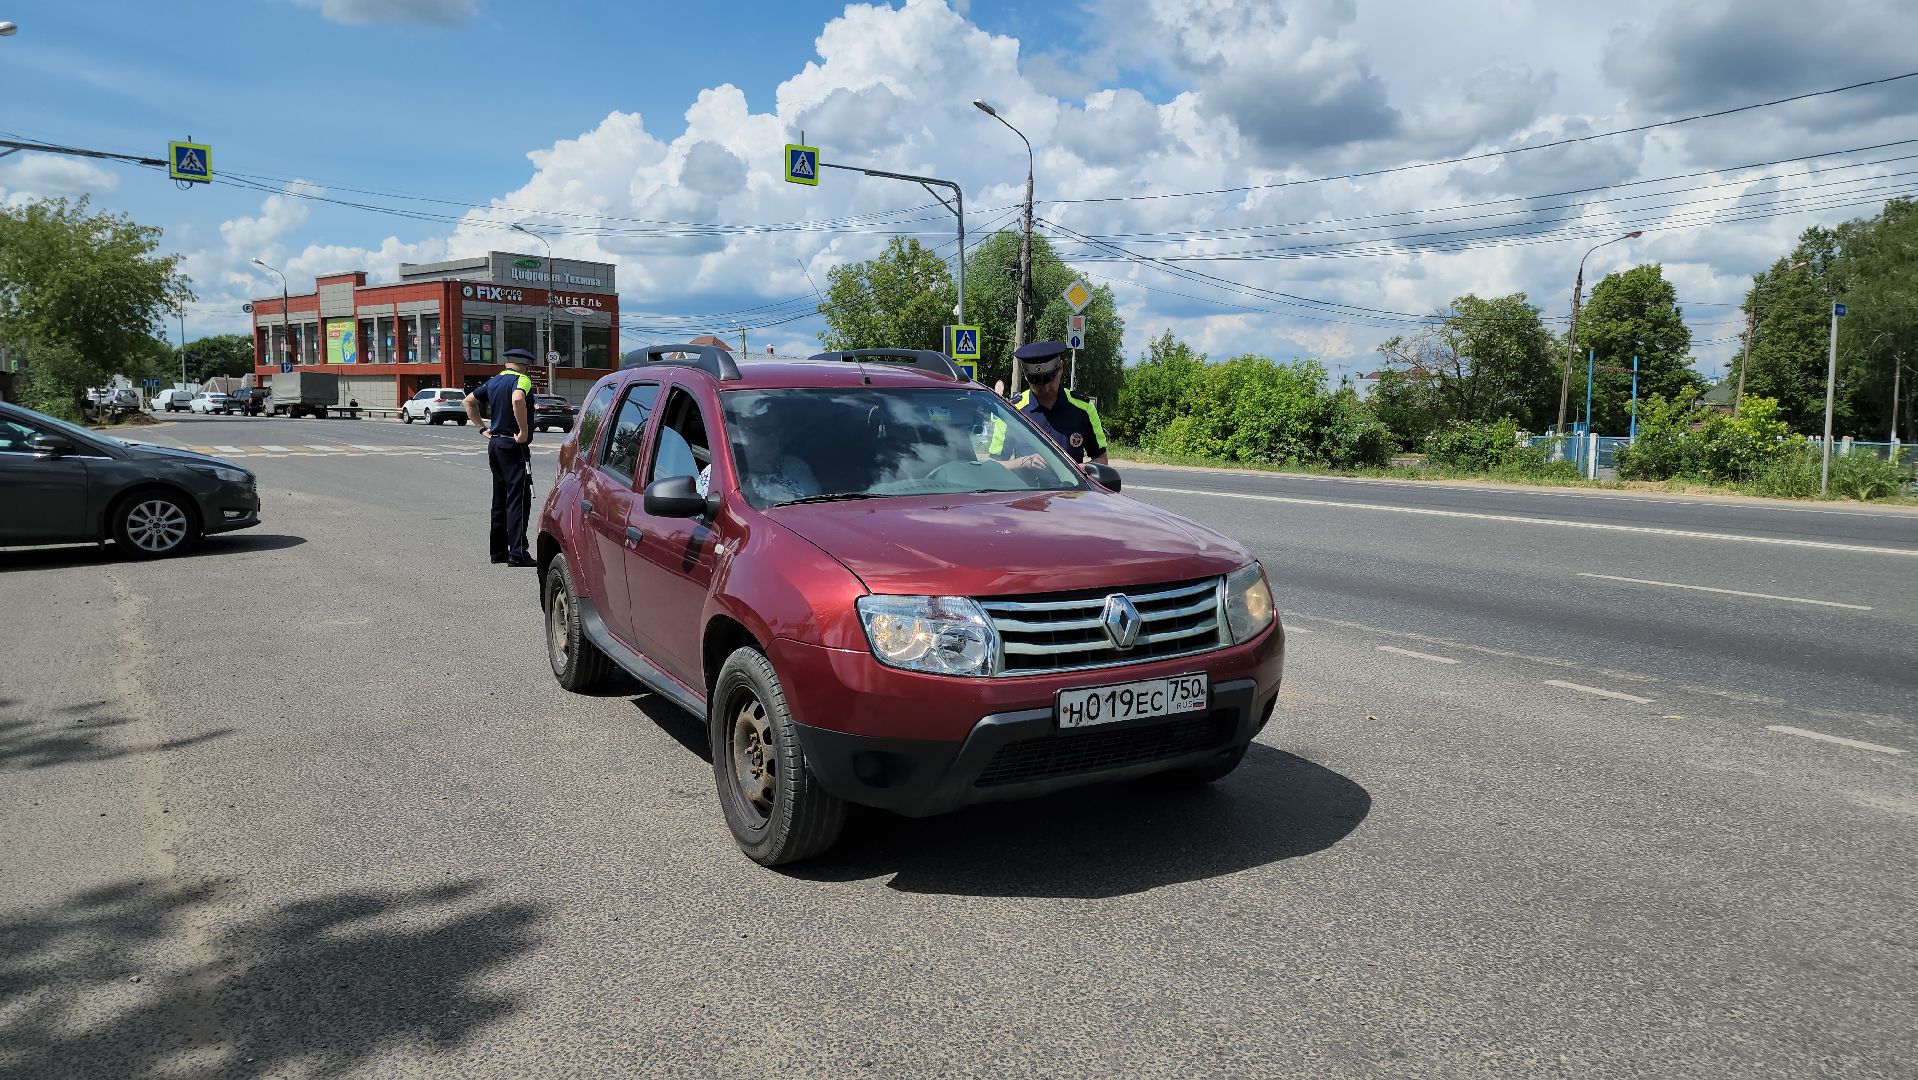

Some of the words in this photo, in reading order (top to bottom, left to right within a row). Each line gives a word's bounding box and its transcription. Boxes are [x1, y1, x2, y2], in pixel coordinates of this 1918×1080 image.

[563, 273, 602, 287] Техника
[554, 295, 602, 308] МЕБЕЛЬ
[1168, 678, 1202, 702] 750
[1176, 700, 1193, 710] RUS
